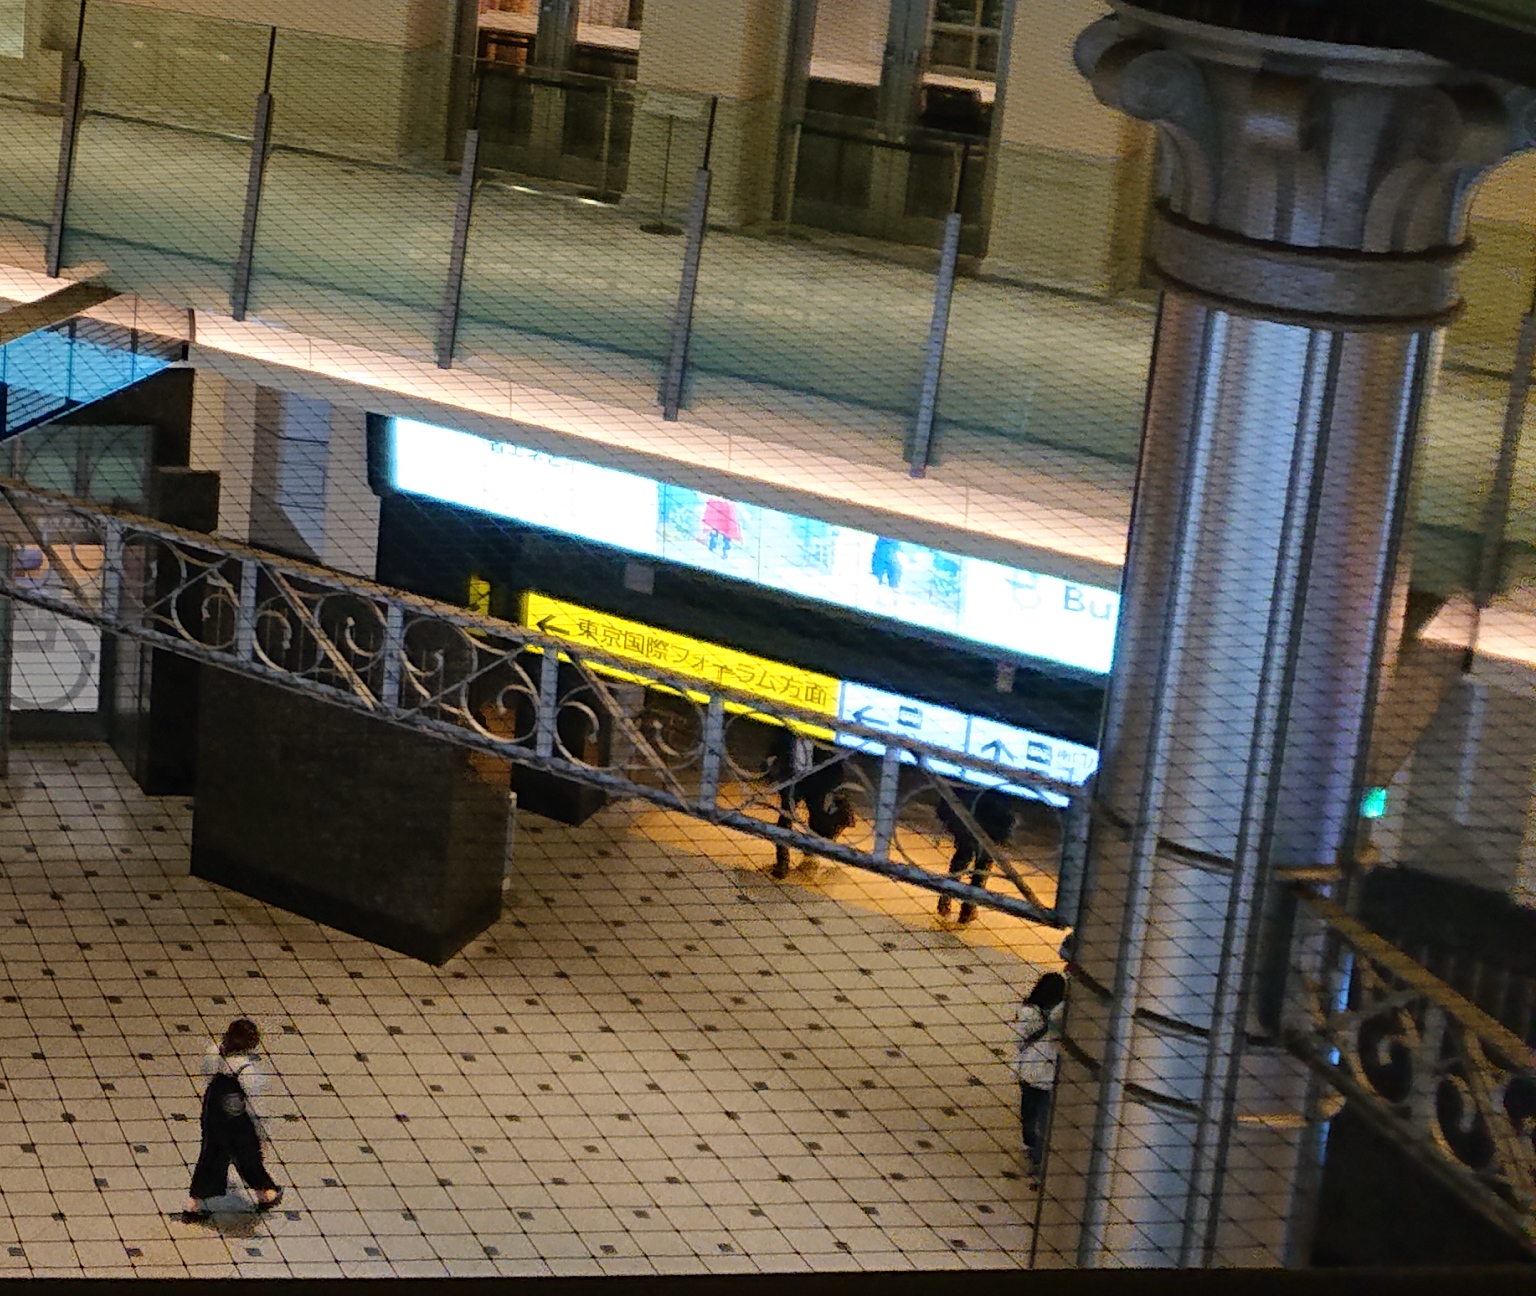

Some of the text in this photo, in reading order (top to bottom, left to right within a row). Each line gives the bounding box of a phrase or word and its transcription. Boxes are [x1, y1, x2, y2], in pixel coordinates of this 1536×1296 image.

[577, 617, 827, 706] 東京国際フォーラム方面
